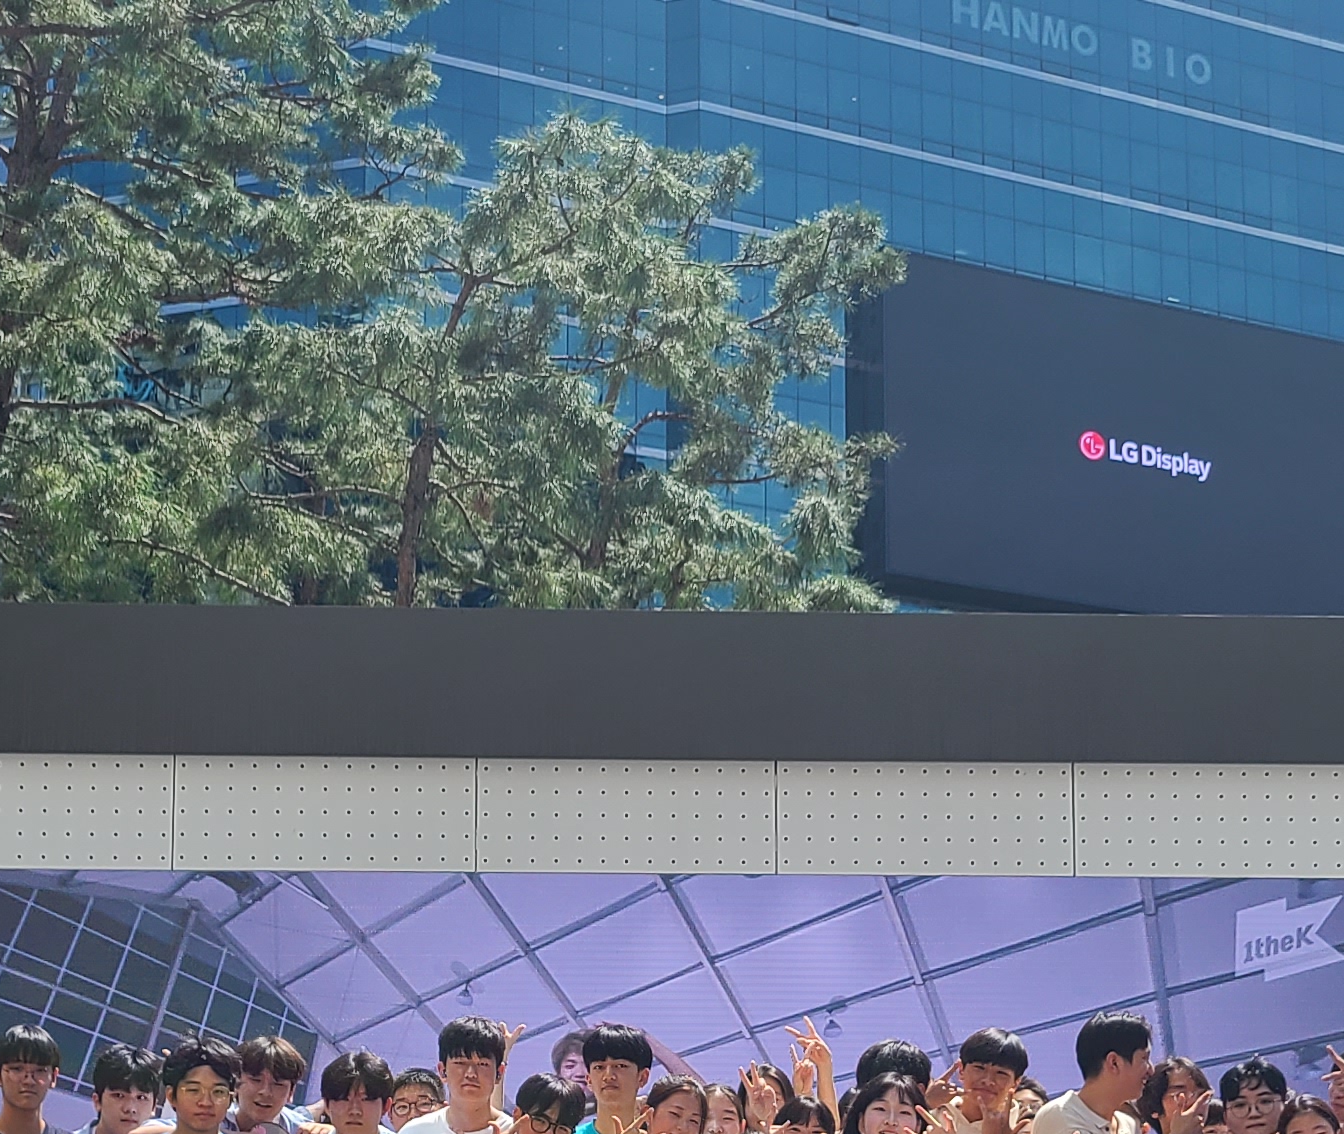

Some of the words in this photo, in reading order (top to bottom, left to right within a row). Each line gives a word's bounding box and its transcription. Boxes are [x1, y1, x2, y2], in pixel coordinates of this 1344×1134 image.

[953, 0, 1099, 57] HANMO
[1131, 38, 1212, 86] BIO
[1109, 438, 1138, 464] LG
[1141, 444, 1211, 482] Display
[1243, 923, 1316, 964] 1theK
